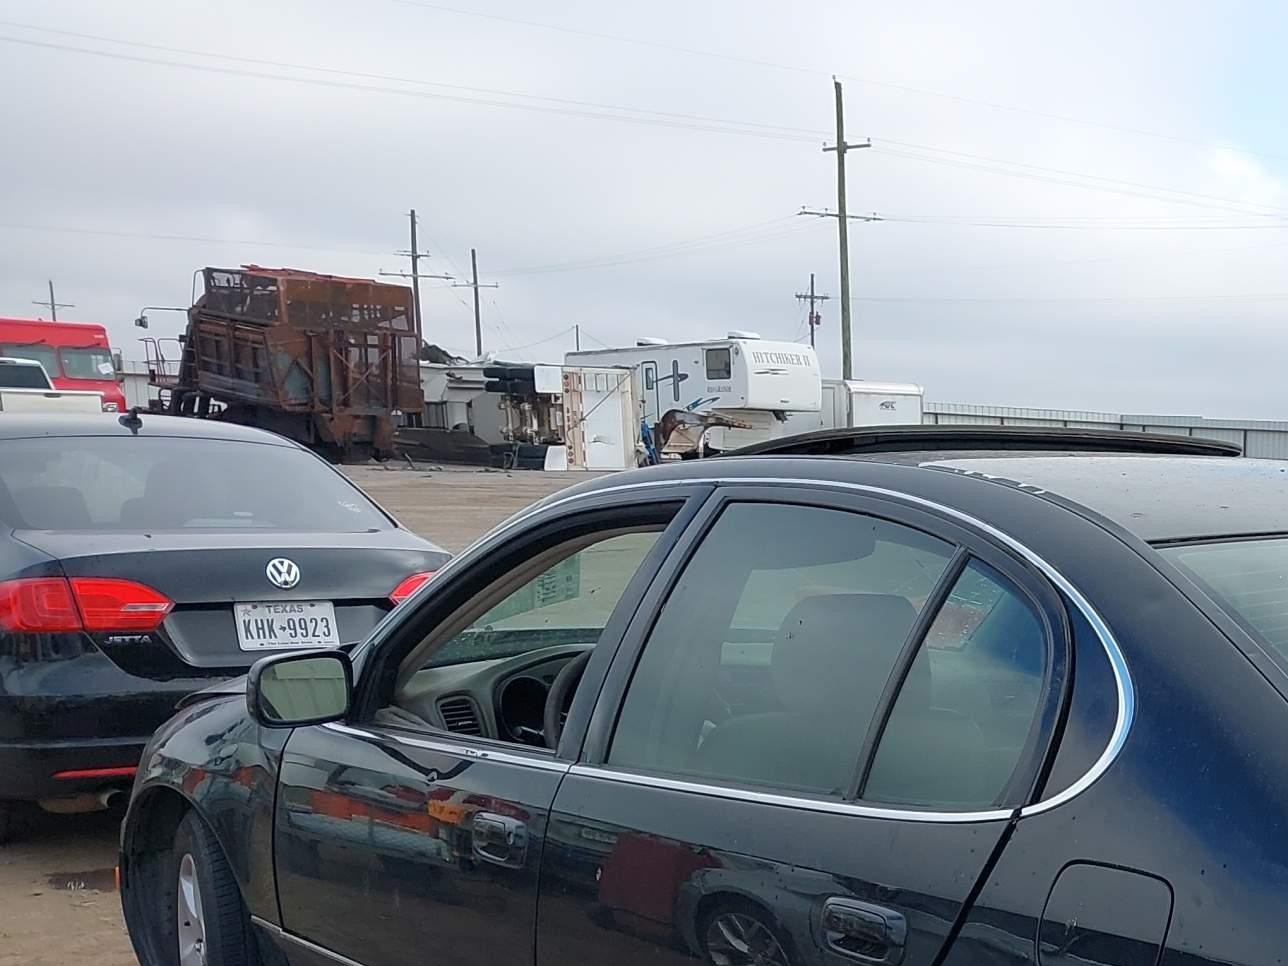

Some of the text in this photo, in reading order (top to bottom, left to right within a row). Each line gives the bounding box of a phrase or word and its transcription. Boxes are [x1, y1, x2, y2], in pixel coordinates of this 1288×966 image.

[265, 604, 304, 614] TEXAS
[242, 616, 332, 641] KHK 9923
[103, 634, 153, 645] JETTA
